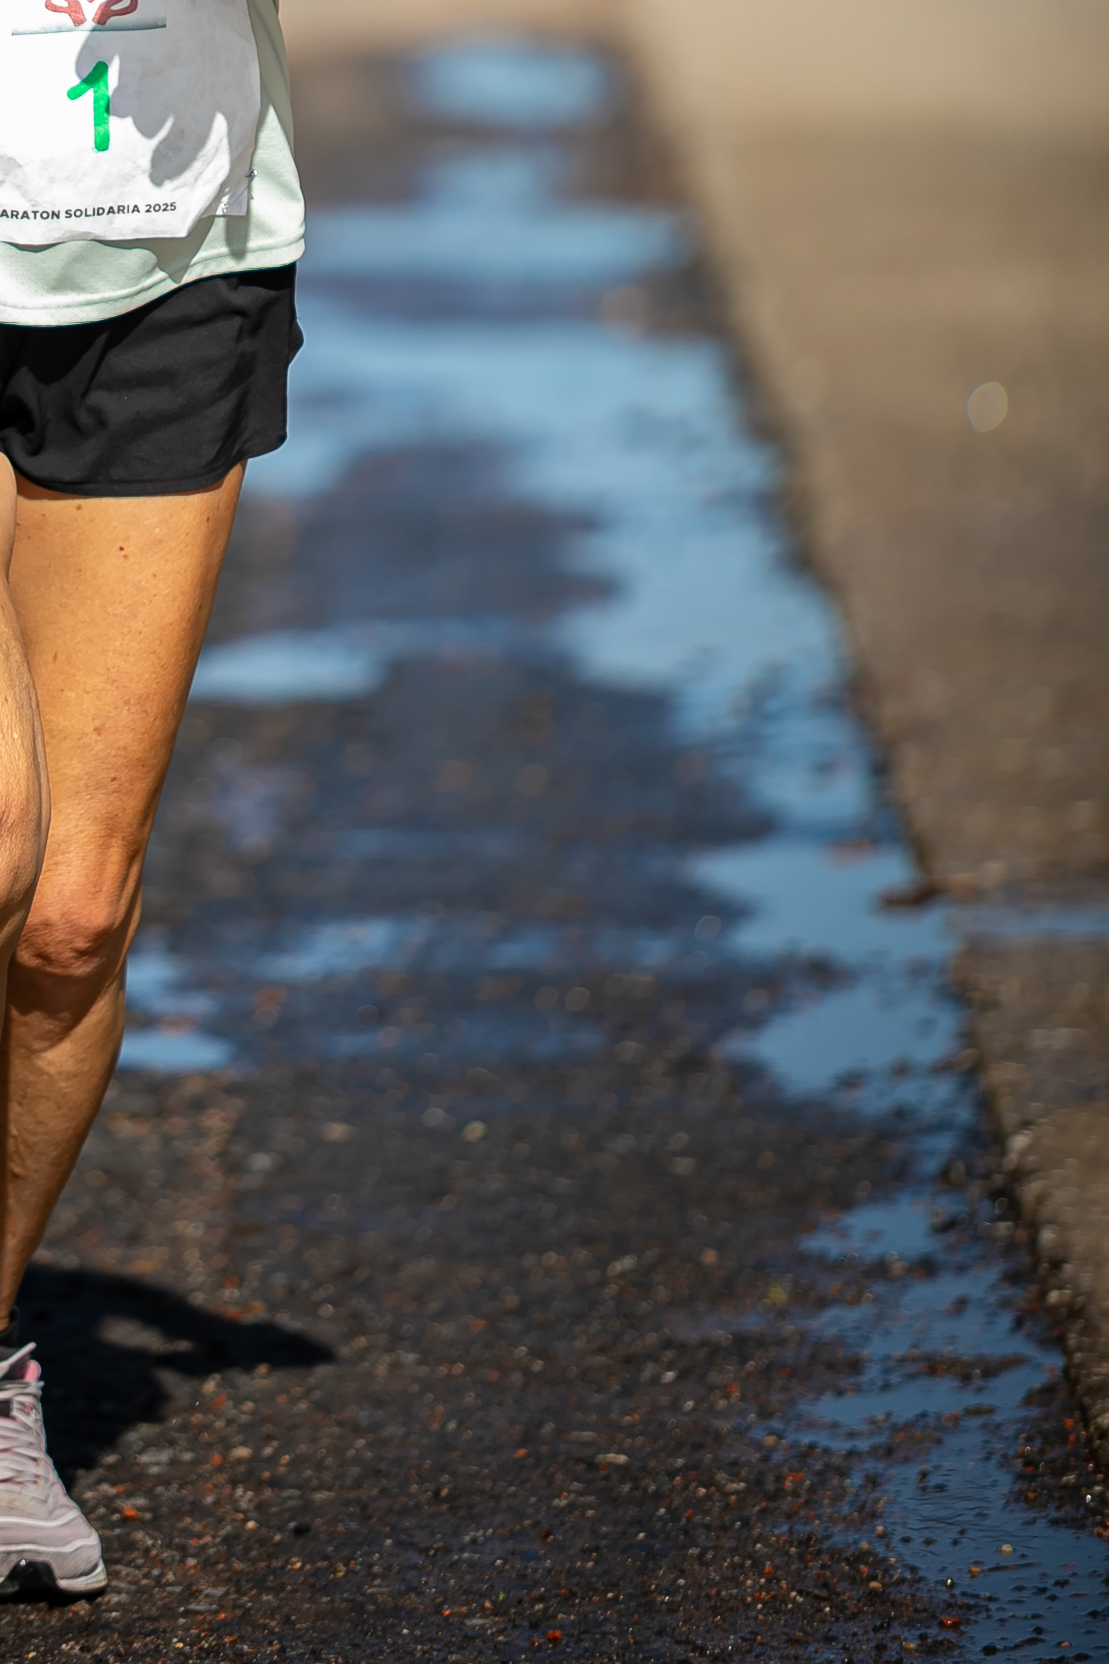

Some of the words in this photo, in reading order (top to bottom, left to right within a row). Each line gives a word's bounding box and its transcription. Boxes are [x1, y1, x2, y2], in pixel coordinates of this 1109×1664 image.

[67, 60, 110, 152] 1
[64, 204, 140, 219] SOLIDARIA
[144, 202, 177, 213] 2025
